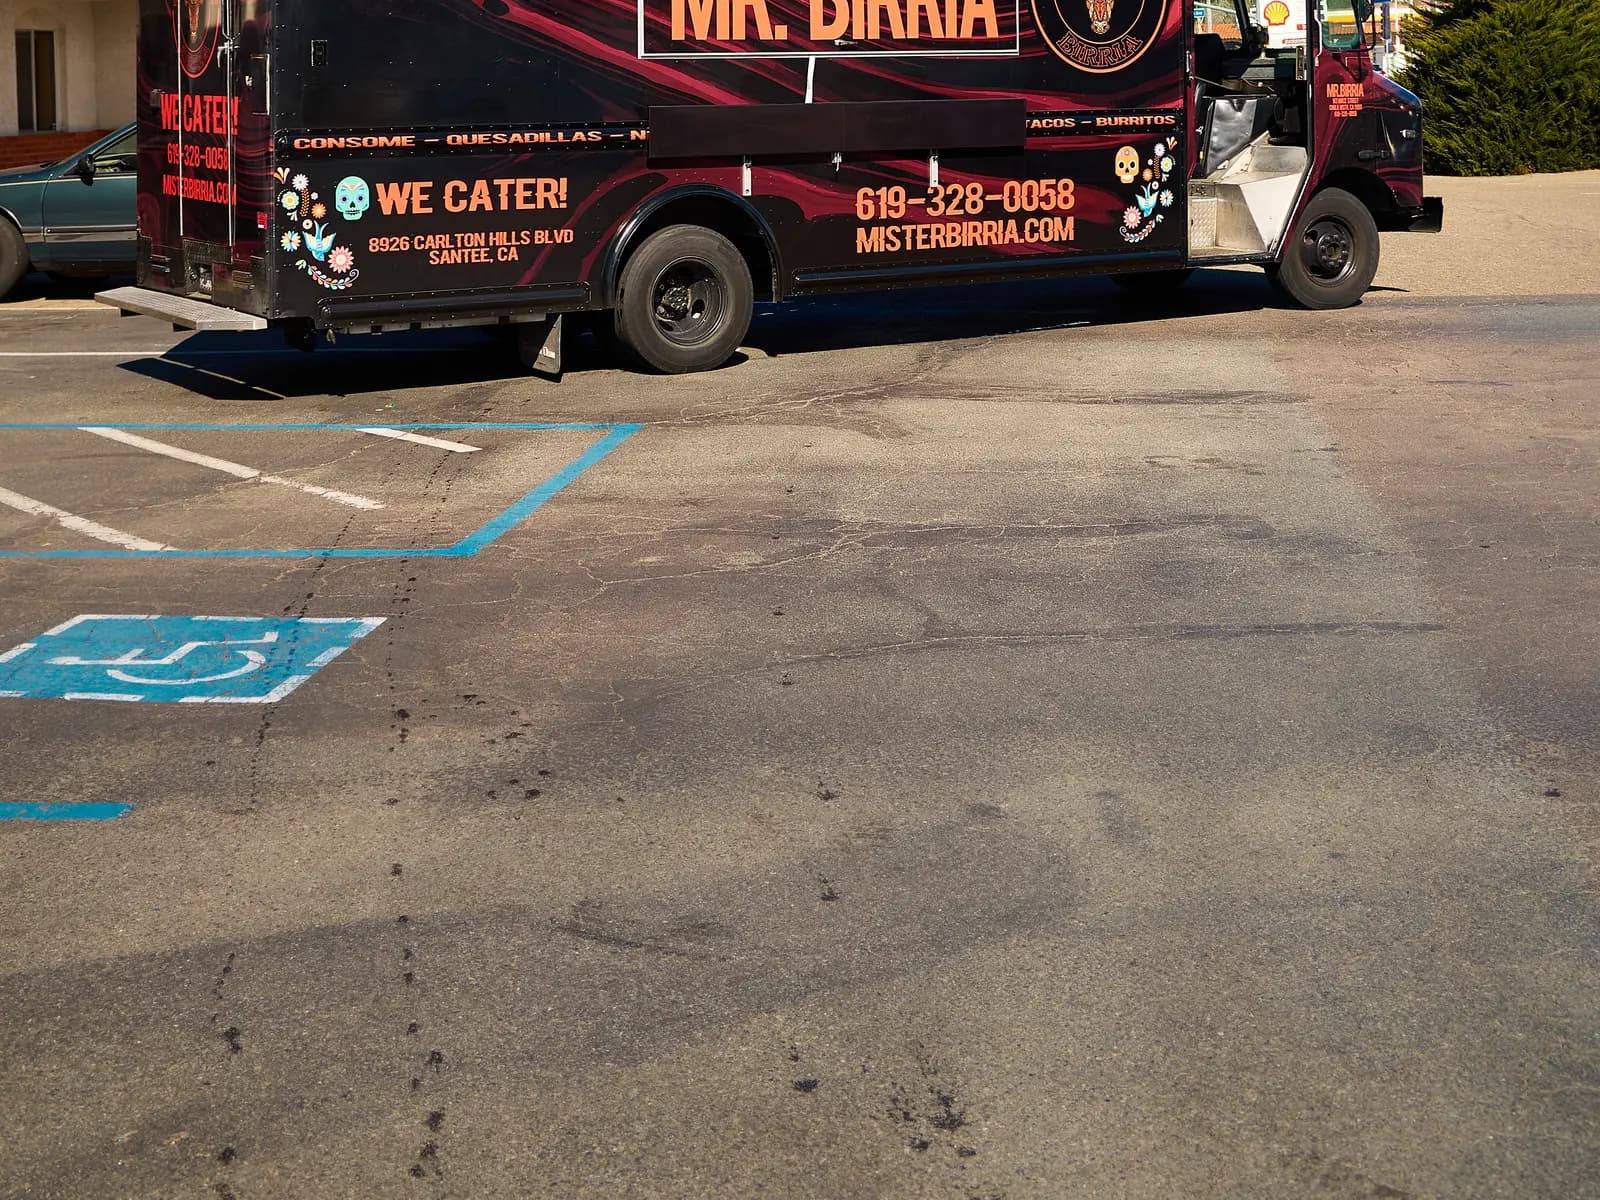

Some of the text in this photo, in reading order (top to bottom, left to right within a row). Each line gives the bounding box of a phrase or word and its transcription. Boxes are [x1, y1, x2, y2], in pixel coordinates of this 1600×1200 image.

[1055, 31, 1144, 68] BIRRIA
[160, 93, 180, 131] WE
[1096, 115, 1176, 128] BURRITOS
[293, 134, 416, 150] CONSOME
[446, 130, 602, 146] QUESADILLAS
[375, 177, 568, 216] WE CATER!
[855, 178, 1076, 221] 619-328-0058
[368, 228, 575, 253] 8926 CARLTON HILLS BLVD
[856, 216, 1075, 254] MISTERBIRRIA.COM
[429, 246, 519, 266] SANTEE, CA
